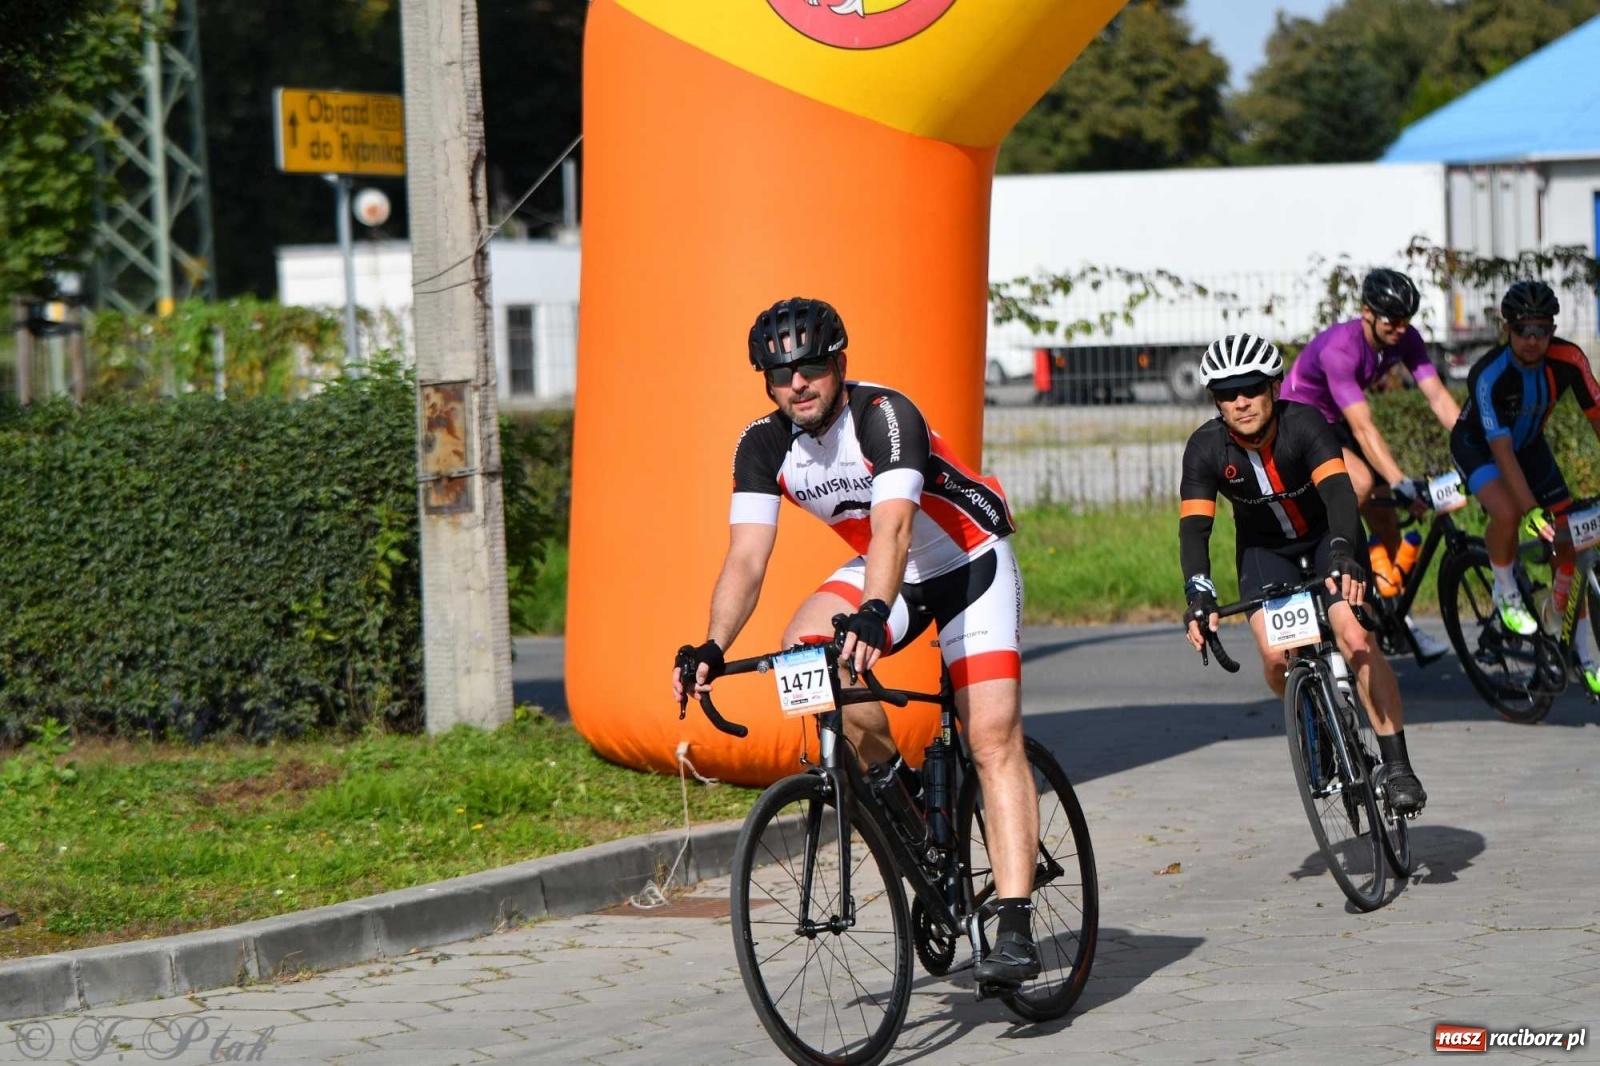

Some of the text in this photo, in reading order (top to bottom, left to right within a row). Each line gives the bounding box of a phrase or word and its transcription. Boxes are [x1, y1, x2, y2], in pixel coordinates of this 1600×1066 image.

[309, 131, 333, 161] do
[944, 480, 1000, 526] OSQUARE
[1573, 515, 1600, 536] 198
[1272, 607, 1310, 631] 099
[780, 668, 825, 694] 1477
